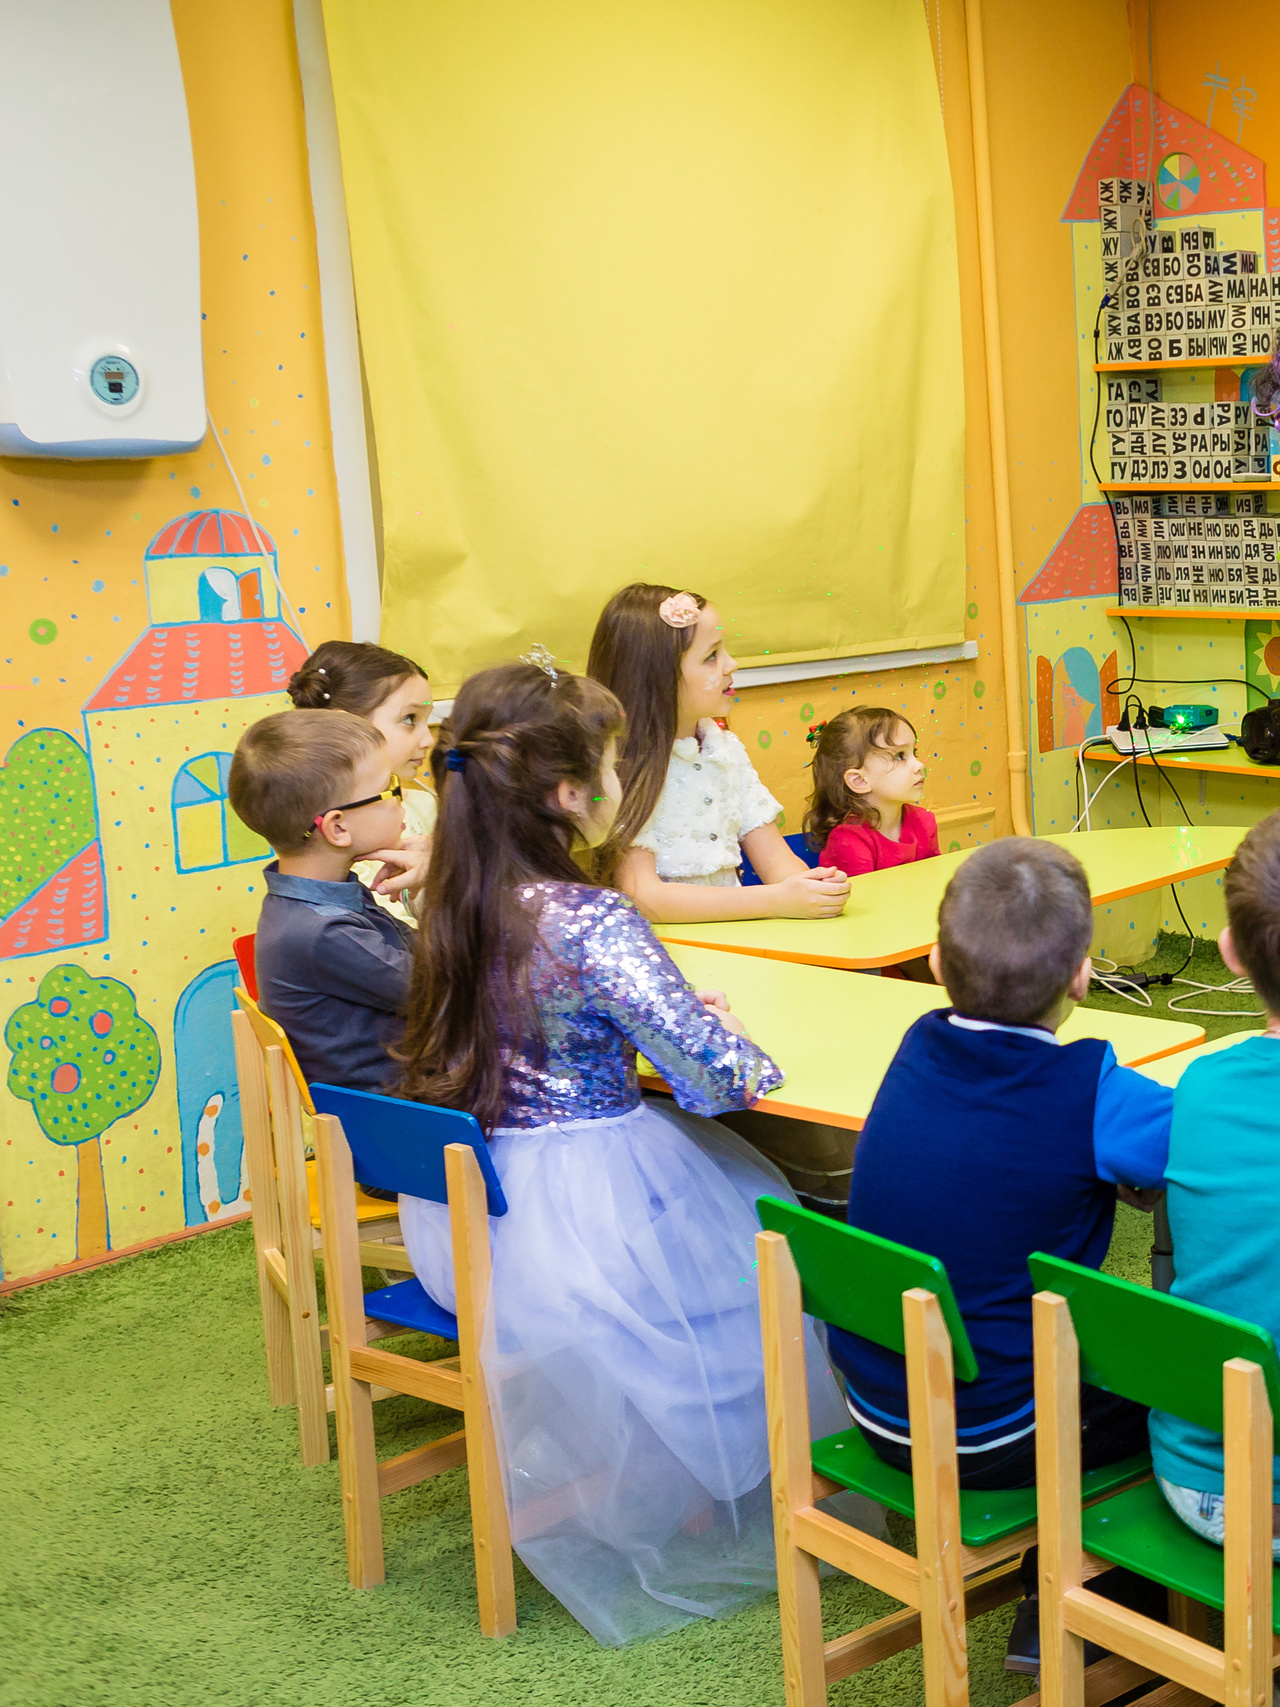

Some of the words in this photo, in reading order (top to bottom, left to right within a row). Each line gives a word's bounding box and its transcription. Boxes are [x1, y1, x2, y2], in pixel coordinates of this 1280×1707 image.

[1100, 180, 1114, 204] ЖУ
[1119, 179, 1132, 204] ЖЬ
[1103, 207, 1117, 231] ЖУ
[1102, 236, 1119, 256] ЖУ
[1161, 235, 1174, 253] В
[1180, 231, 1199, 251] БЫ
[1202, 230, 1214, 250] Б
[1104, 260, 1119, 282] ЖУ
[1125, 257, 1140, 282] ВО
[1143, 257, 1161, 278] ВЭ
[1163, 256, 1181, 277] БО
[1186, 253, 1201, 278] БО
[1204, 255, 1220, 275] БА
[1222, 252, 1238, 275] М
[1241, 253, 1256, 273] МЫ
[1126, 285, 1140, 309] ВО
[1146, 283, 1162, 307] ВЭ
[1166, 284, 1184, 304] БЭ
[1186, 283, 1204, 302] БА
[1208, 279, 1223, 303] МУ
[1226, 279, 1246, 299] МА
[1249, 277, 1268, 297] НА
[1105, 287, 1120, 311] У
[1107, 314, 1122, 337] ЖУ
[1127, 312, 1141, 335] ВА
[1144, 312, 1163, 332] ВЭ
[1165, 311, 1183, 331] БО
[1186, 310, 1205, 330] БЫ
[1208, 309, 1227, 329] МУ
[1231, 304, 1247, 329] МО
[1251, 305, 1270, 326] НЫ
[1107, 341, 1124, 361] ЖУ
[1127, 338, 1142, 361] ВУ
[1148, 337, 1163, 361] ВО
[1168, 338, 1183, 358] Б
[1188, 337, 1206, 357] БЫ
[1209, 336, 1228, 356] МЫ
[1232, 332, 1247, 356] МЭ
[1251, 333, 1270, 353] НО
[1108, 381, 1125, 402] ГА
[1128, 380, 1142, 403] ГЭ
[1145, 379, 1159, 402] ГУ
[1107, 408, 1124, 428] ГО
[1129, 405, 1147, 428] ДУ
[1151, 404, 1166, 429] ЛУ
[1169, 406, 1188, 427] ЗЭ
[1192, 407, 1205, 426] Р
[1216, 402, 1232, 427] РА
[1234, 405, 1250, 425] РУ
[1111, 432, 1126, 456] ГУ
[1130, 431, 1148, 455] ДЫ
[1152, 432, 1167, 455] ЛУ
[1172, 431, 1187, 454] ЗА
[1190, 433, 1209, 453] РА
[1212, 433, 1231, 452] РЫ
[1233, 429, 1246, 453] РА
[1254, 432, 1269, 453] РА
[1111, 461, 1128, 480] ГУ
[1131, 459, 1149, 481] ДЭ
[1150, 459, 1169, 479] ЛЭ
[1173, 459, 1188, 480] З
[1192, 459, 1210, 479] РО
[1213, 459, 1232, 479] РО
[1115, 500, 1129, 515] ВЬ
[1134, 499, 1150, 514] МЯ
[1152, 497, 1162, 516] МЕ
[1167, 495, 1179, 515] ЛИ
[1185, 495, 1196, 515] ЛЬ
[1200, 495, 1212, 515] НЬ
[1235, 498, 1252, 513] БИ
[1120, 520, 1131, 539] ВЬ
[1137, 519, 1148, 538] МИ
[1153, 520, 1165, 540] ЛИ
[1170, 521, 1186, 537] ЛЮ
[1188, 522, 1203, 536] НЕ
[1206, 522, 1221, 538] НЮ
[1224, 522, 1240, 538] БЮ
[1243, 519, 1256, 539] ДЯ
[1259, 522, 1274, 539] ДЬ
[1119, 541, 1133, 558] ВЁ
[1140, 542, 1152, 561] МИ
[1157, 544, 1172, 560] ЛЮ
[1174, 544, 1189, 559] ЛИ
[1191, 545, 1206, 559] НЕ
[1208, 545, 1224, 559] НИ
[1225, 544, 1240, 559] БЮ
[1245, 543, 1260, 560] ДЯ
[1261, 542, 1275, 562] ДЮ
[1140, 564, 1152, 583] МЬ
[1156, 566, 1172, 581] ЛЬ
[1175, 566, 1190, 581] ЛЯ
[1192, 564, 1205, 584] НЕ
[1209, 567, 1224, 583] НЮ
[1228, 567, 1243, 582] БЯ
[1245, 564, 1260, 584] ДИ
[1262, 567, 1278, 585] ДЬ
[1123, 587, 1138, 602] ВЬ
[1141, 585, 1153, 604] МЬ
[1158, 586, 1173, 604] ЛЁ
[1176, 588, 1191, 603] ЛЕ
[1192, 589, 1208, 603] НЯ
[1211, 589, 1227, 603] НИ
[1229, 589, 1244, 604] БИ
[1245, 587, 1263, 607] ДЁ
[1262, 587, 1280, 607] ДЁ
